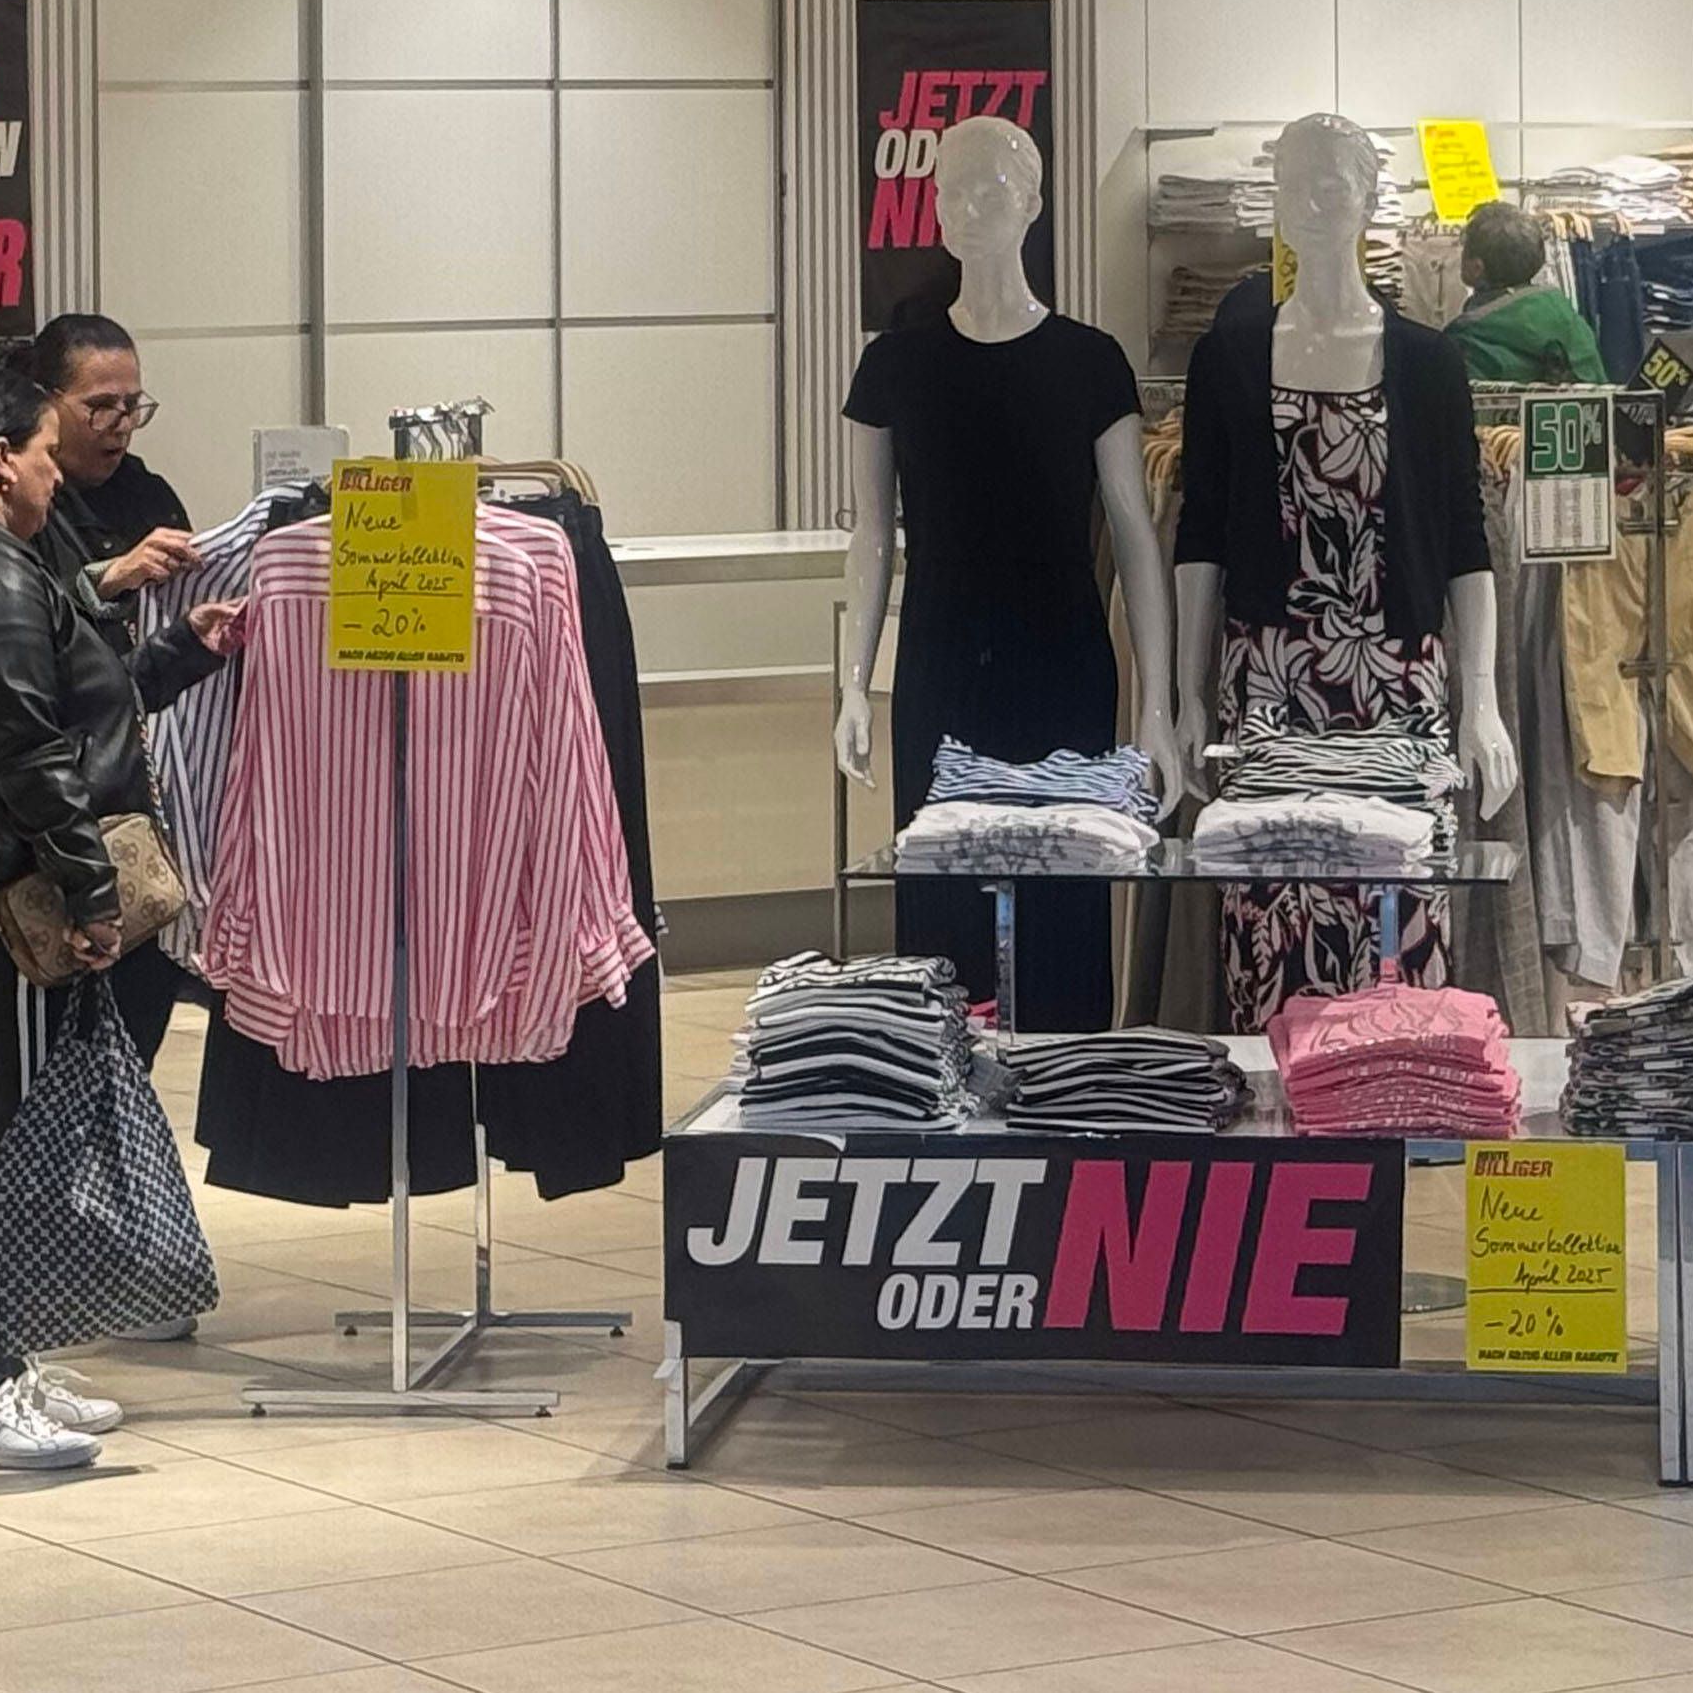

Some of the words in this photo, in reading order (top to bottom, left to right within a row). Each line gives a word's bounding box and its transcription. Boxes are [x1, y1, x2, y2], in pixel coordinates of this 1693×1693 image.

[878, 70, 1048, 130] JETZT
[874, 128, 938, 180] OD
[867, 178, 939, 250] NI
[1643, 347, 1690, 388] 50%
[1531, 402, 1602, 472] 50%
[345, 501, 402, 532] Neue
[366, 567, 410, 602] April
[417, 572, 455, 591] 2025
[1474, 1157, 1553, 1177] BILLIGER
[1480, 1185, 1544, 1221] Neue
[686, 1157, 1047, 1267] JETZT
[877, 1272, 1039, 1331] ODER
[1042, 1159, 1374, 1336] NIE
[1513, 1258, 1560, 1295] April
[1566, 1264, 1612, 1285] 2025
